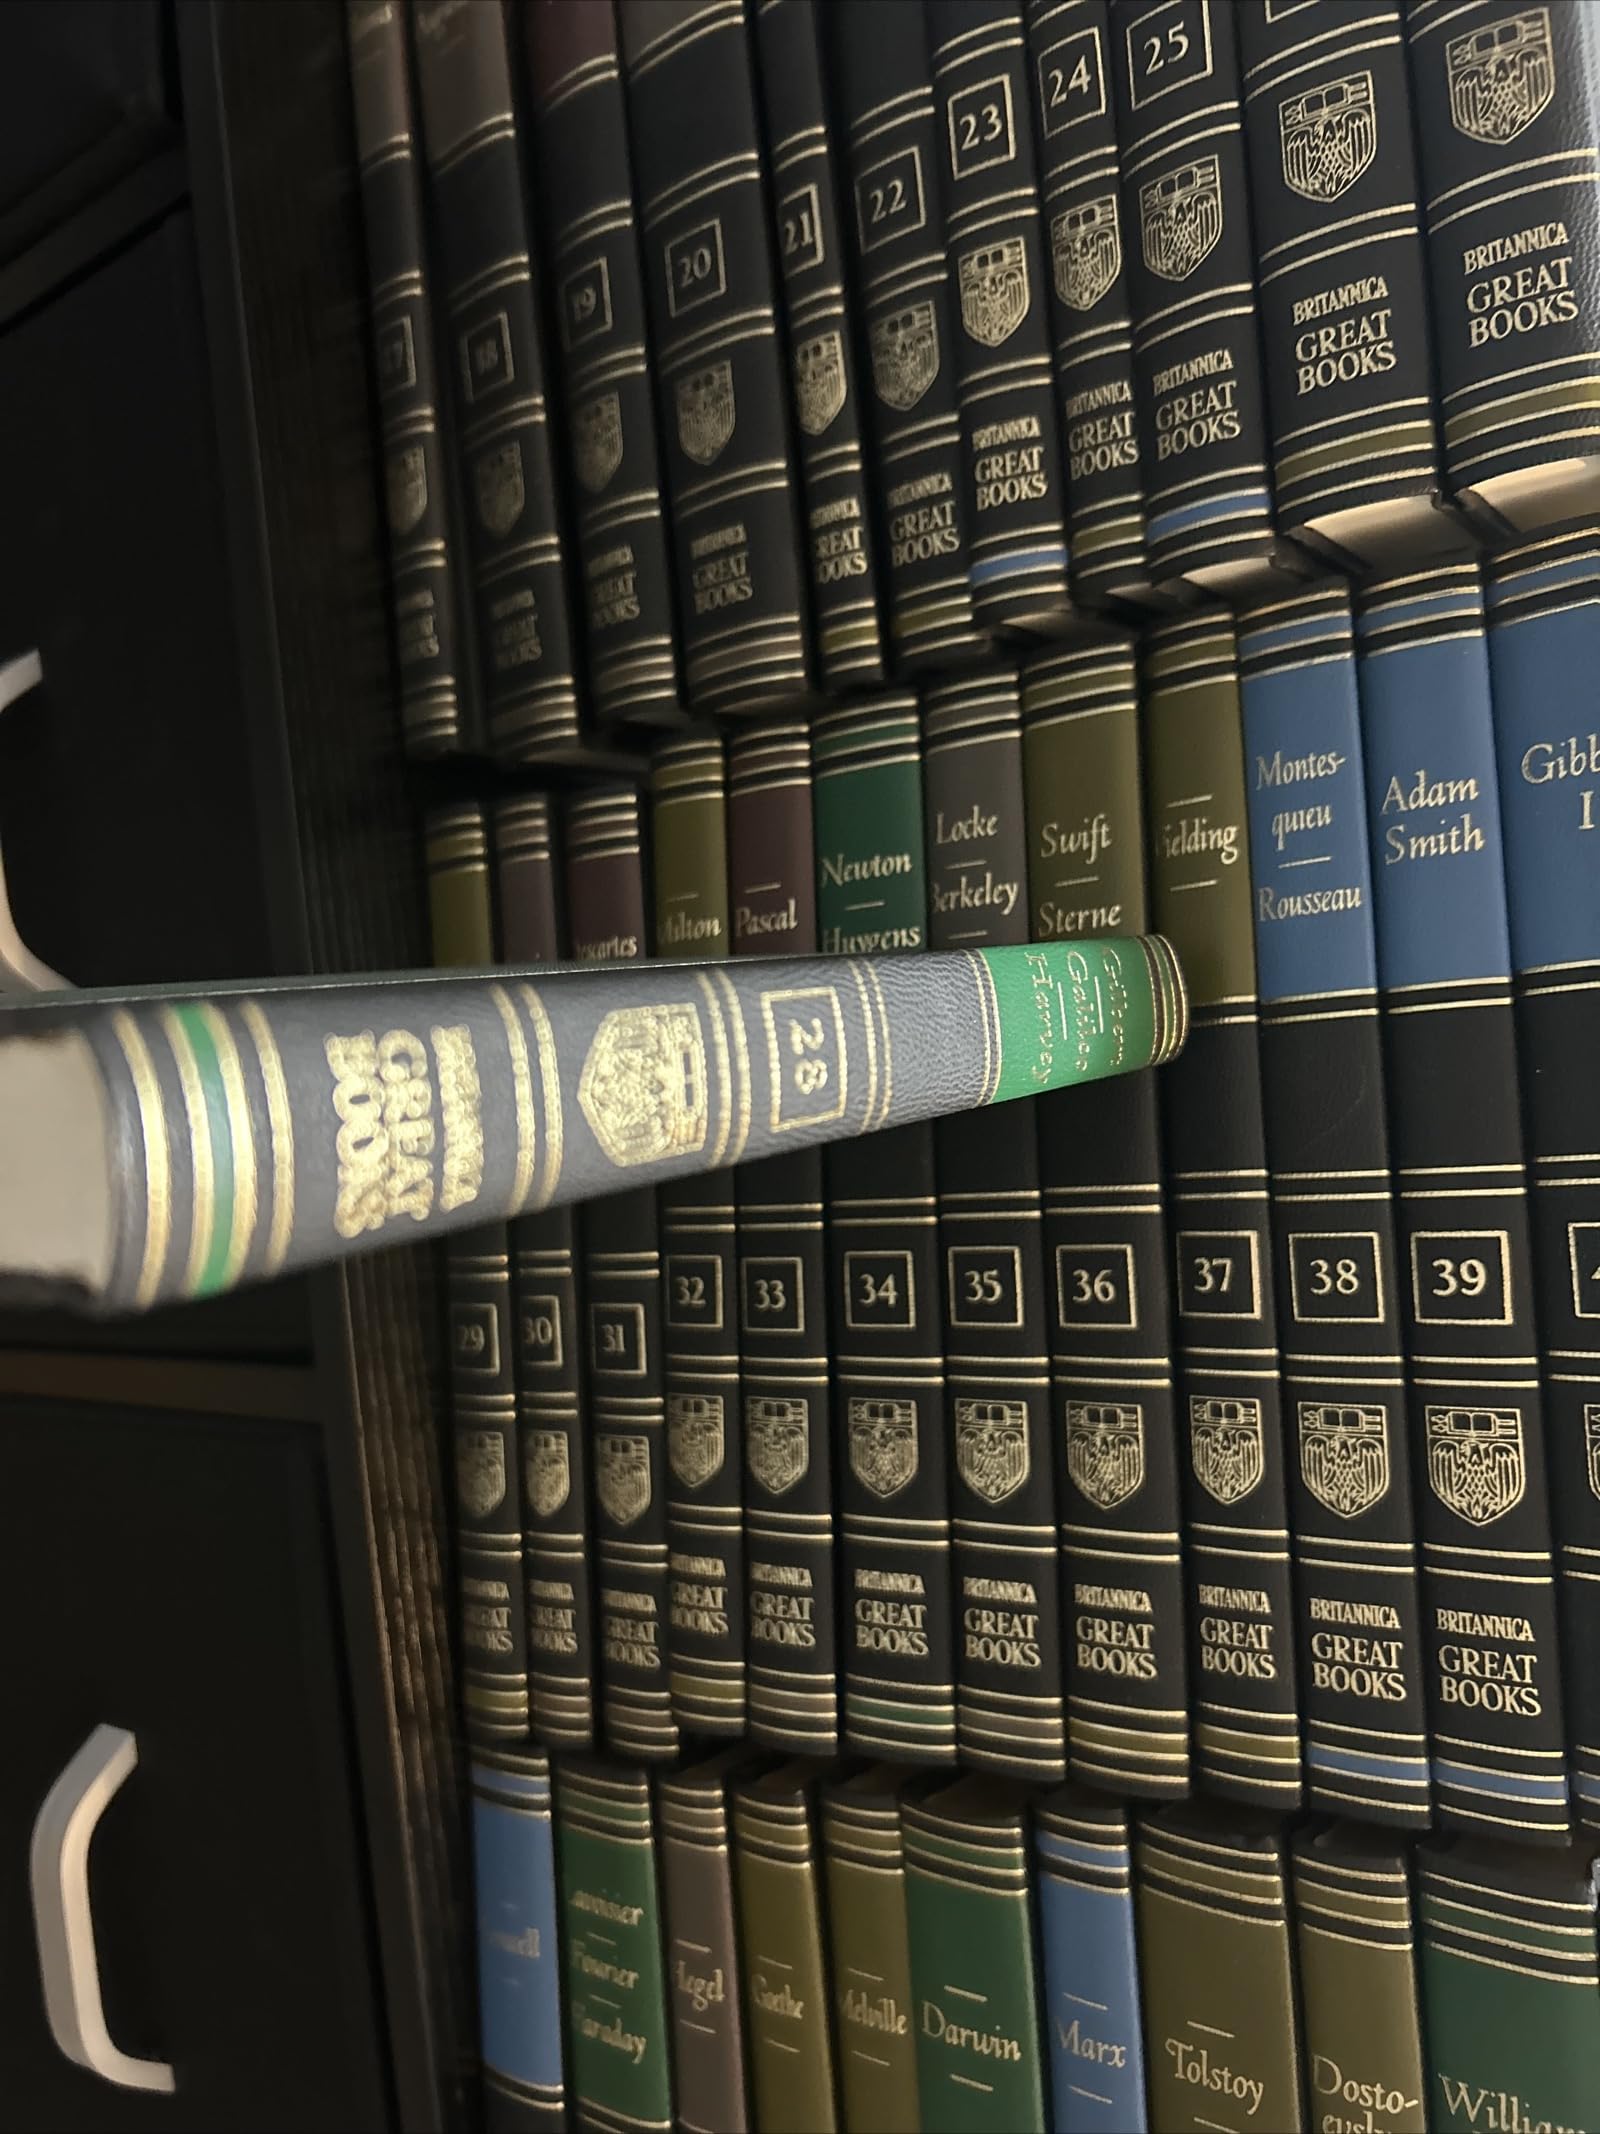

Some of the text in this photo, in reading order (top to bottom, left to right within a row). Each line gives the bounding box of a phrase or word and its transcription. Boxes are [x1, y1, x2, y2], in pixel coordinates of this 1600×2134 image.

[1143, 21, 1189, 76] 25
[1050, 56, 1091, 107] 24
[960, 104, 1001, 150] 23
[871, 180, 907, 222] 22
[679, 247, 711, 288] 20
[1464, 221, 1569, 275] BRITANNICA
[1293, 276, 1390, 326] BRITANNICA
[1467, 257, 1573, 314] GREAT
[1295, 309, 1392, 363] GREAT
[1469, 290, 1579, 348] BOOKS
[1152, 349, 1234, 397] BRITANNICA
[1297, 341, 1398, 395] BOOKS
[1155, 381, 1238, 432] GREAT
[1068, 411, 1136, 453] GREAT
[1157, 410, 1242, 460] BOOKS
[975, 446, 1044, 484] GREAT
[1070, 441, 1139, 479] BOOKS
[976, 472, 1048, 511] BOOKS
[890, 500, 955, 541] GREAT
[891, 527, 960, 567] BOOKS
[1255, 748, 1347, 791] Montes-
[1380, 769, 1479, 816] Adam
[1578, 790, 1595, 831] I
[936, 804, 999, 844] Locke
[1040, 813, 1112, 865] Swift
[1272, 804, 1333, 852] quieu
[1385, 813, 1485, 866] Smith
[820, 853, 912, 888] Newton
[1038, 901, 1122, 938] Sterne
[1258, 885, 1362, 923] Rousseau
[790, 1018, 828, 1095] 28
[677, 1275, 707, 1309] 32
[754, 1279, 787, 1312] 33
[859, 1273, 899, 1308] 34
[964, 1268, 1003, 1305] 35
[1072, 1268, 1116, 1305] 36
[1193, 1256, 1233, 1294] 37
[1309, 1258, 1360, 1296] 38
[1431, 1258, 1489, 1297] 39
[855, 1598, 928, 1630] GREAT
[963, 1607, 1040, 1640] GREAT
[1075, 1615, 1156, 1650] GREAT
[1199, 1616, 1275, 1651] GREAT
[1309, 1597, 1402, 1630] BRITANNICA
[1436, 1607, 1536, 1643] BRITANNICA
[855, 1624, 929, 1657] BOOKS
[964, 1633, 1042, 1669] BOOKS
[1311, 1631, 1404, 1670] GREAT
[1076, 1642, 1159, 1681] BOOKS
[1201, 1643, 1280, 1681] BOOKS
[1312, 1660, 1408, 1702] BOOKS
[1438, 1643, 1538, 1684] GREAT
[1439, 1674, 1543, 1717] BOOKS
[921, 2000, 1022, 2062] Darwin
[1058, 2019, 1128, 2068] Marx
[1165, 2037, 1265, 2115] Tolstoy
[1313, 2054, 1419, 2115] Dosto-
